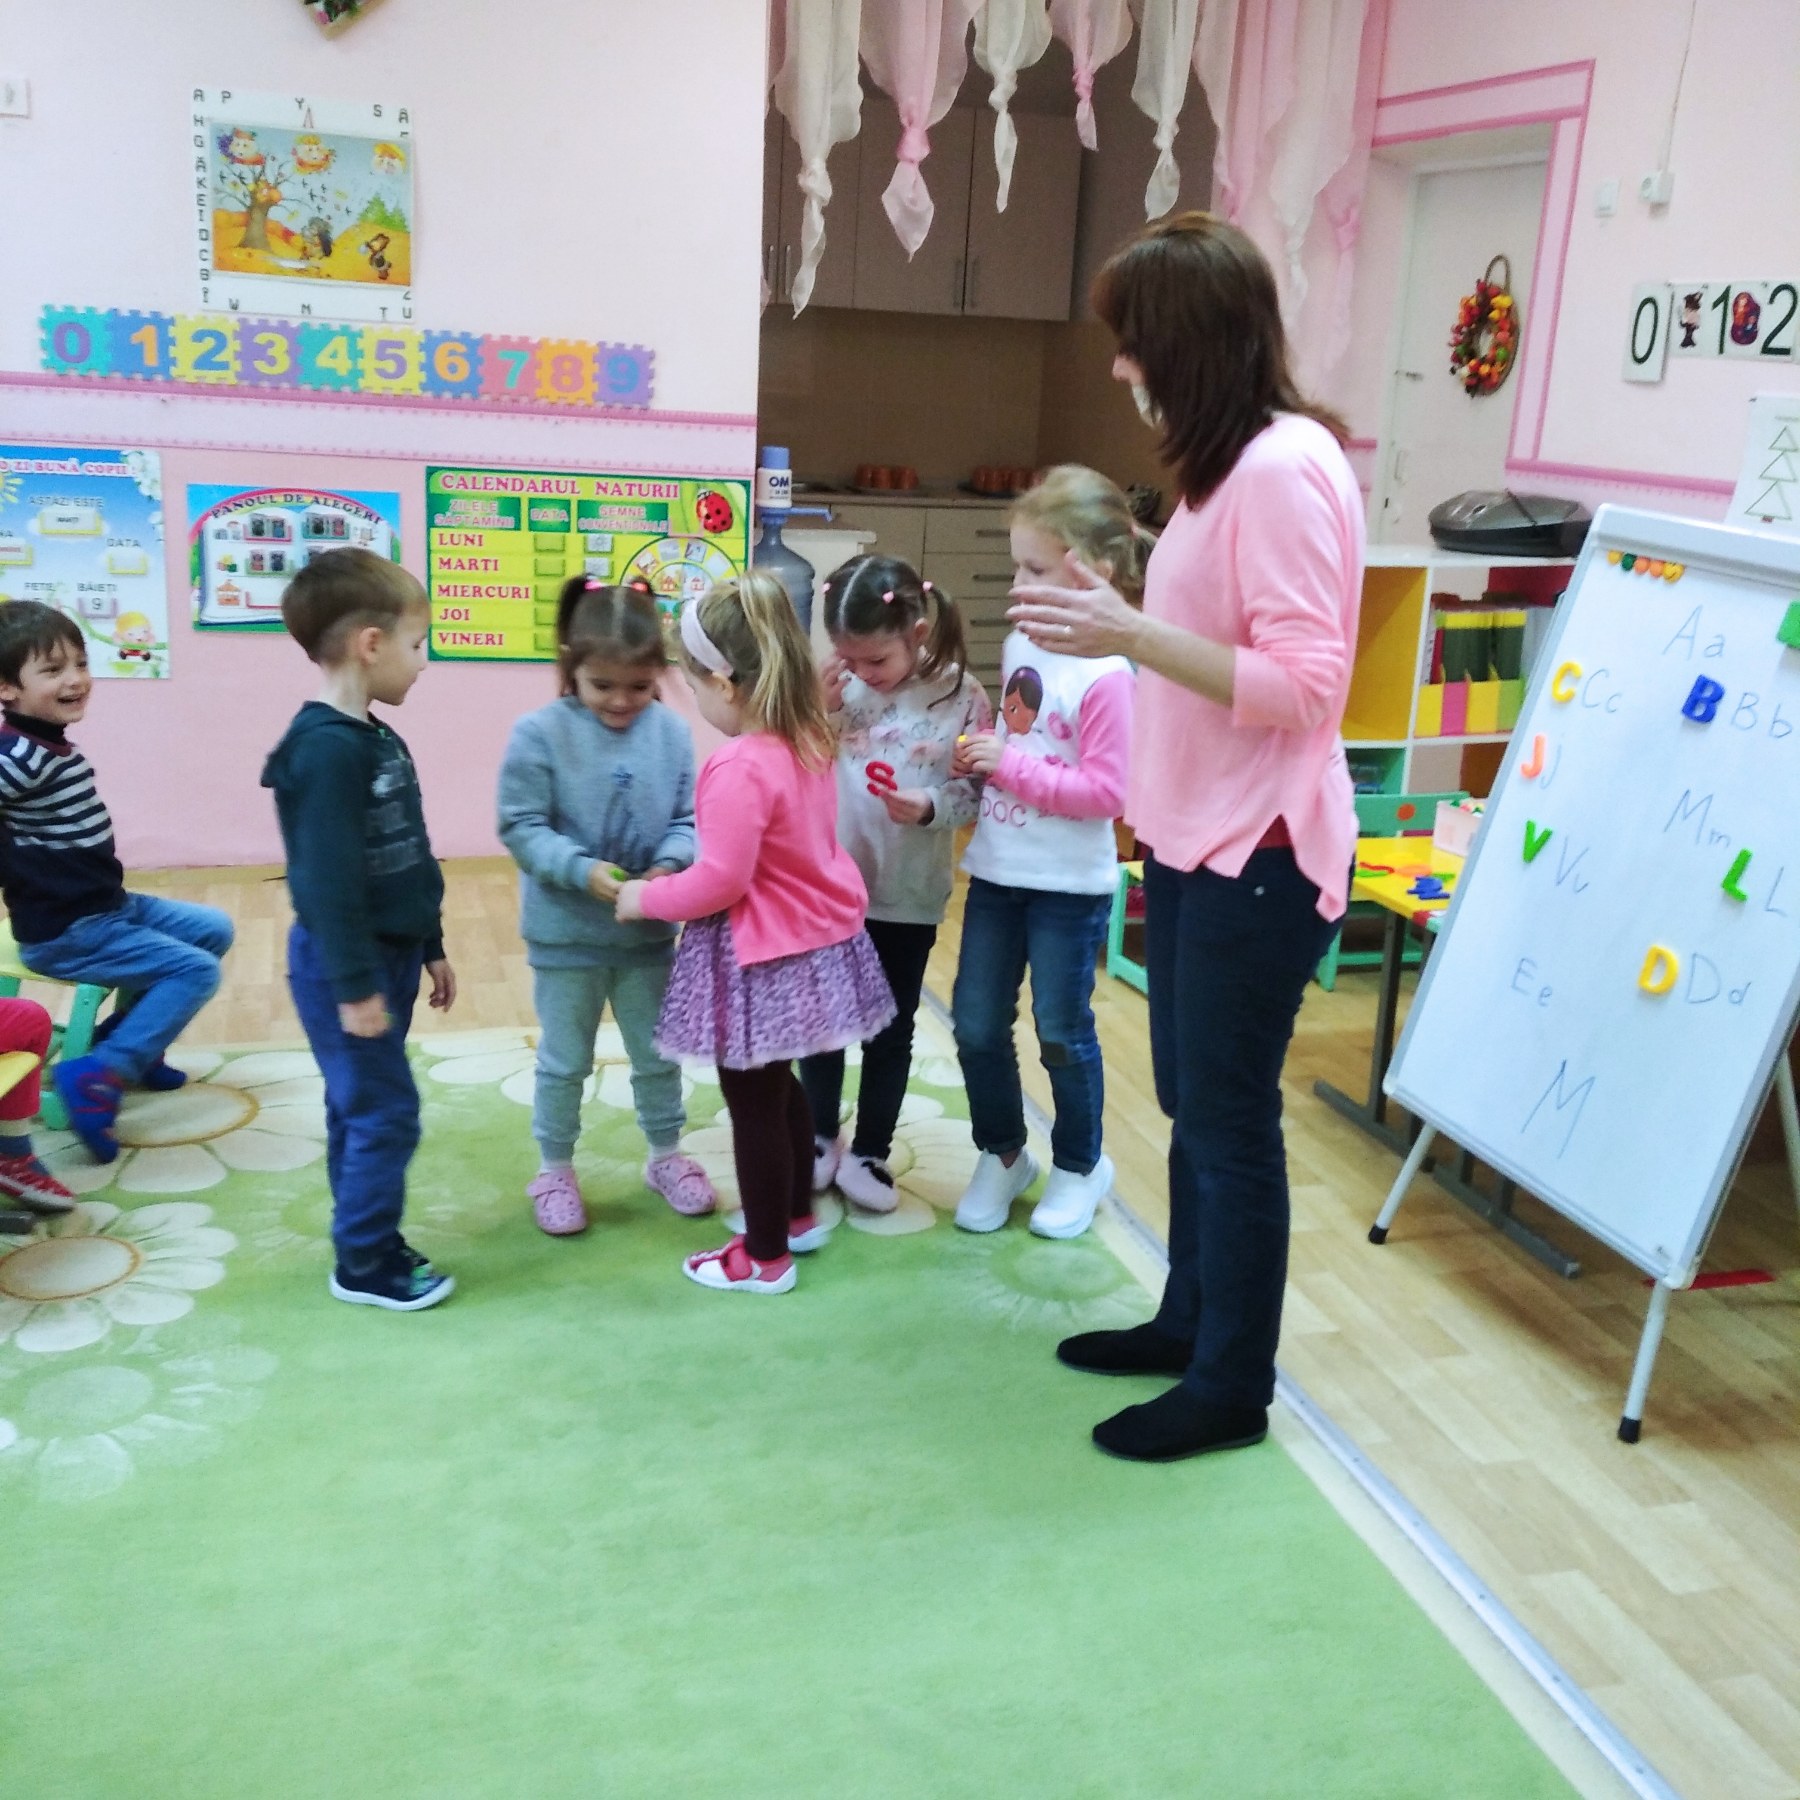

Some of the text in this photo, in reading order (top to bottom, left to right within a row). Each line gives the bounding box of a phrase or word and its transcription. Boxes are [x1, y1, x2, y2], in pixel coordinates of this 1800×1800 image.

[1631, 283, 1799, 364] 0 1 2
[54, 322, 640, 394] 0 1 2 3 4 5 6 7 8 9
[211, 494, 278, 519] PANOUL
[283, 493, 305, 504] DE
[441, 474, 680, 498] CALENDARUL NATURII
[450, 500, 497, 513] ZILELE
[599, 505, 645, 518] SEMNE
[438, 533, 484, 546] LUNI
[437, 584, 530, 599] MIERCURI
[439, 607, 471, 621] JOI
[438, 631, 504, 646] VINERI
[1551, 660, 1583, 704] C
[1681, 674, 1726, 724] B
[1520, 734, 1547, 780] J
[1522, 819, 1553, 864] V
[1720, 848, 1753, 903] L
[1637, 944, 1680, 996] D
[1521, 1058, 1597, 1161] M
